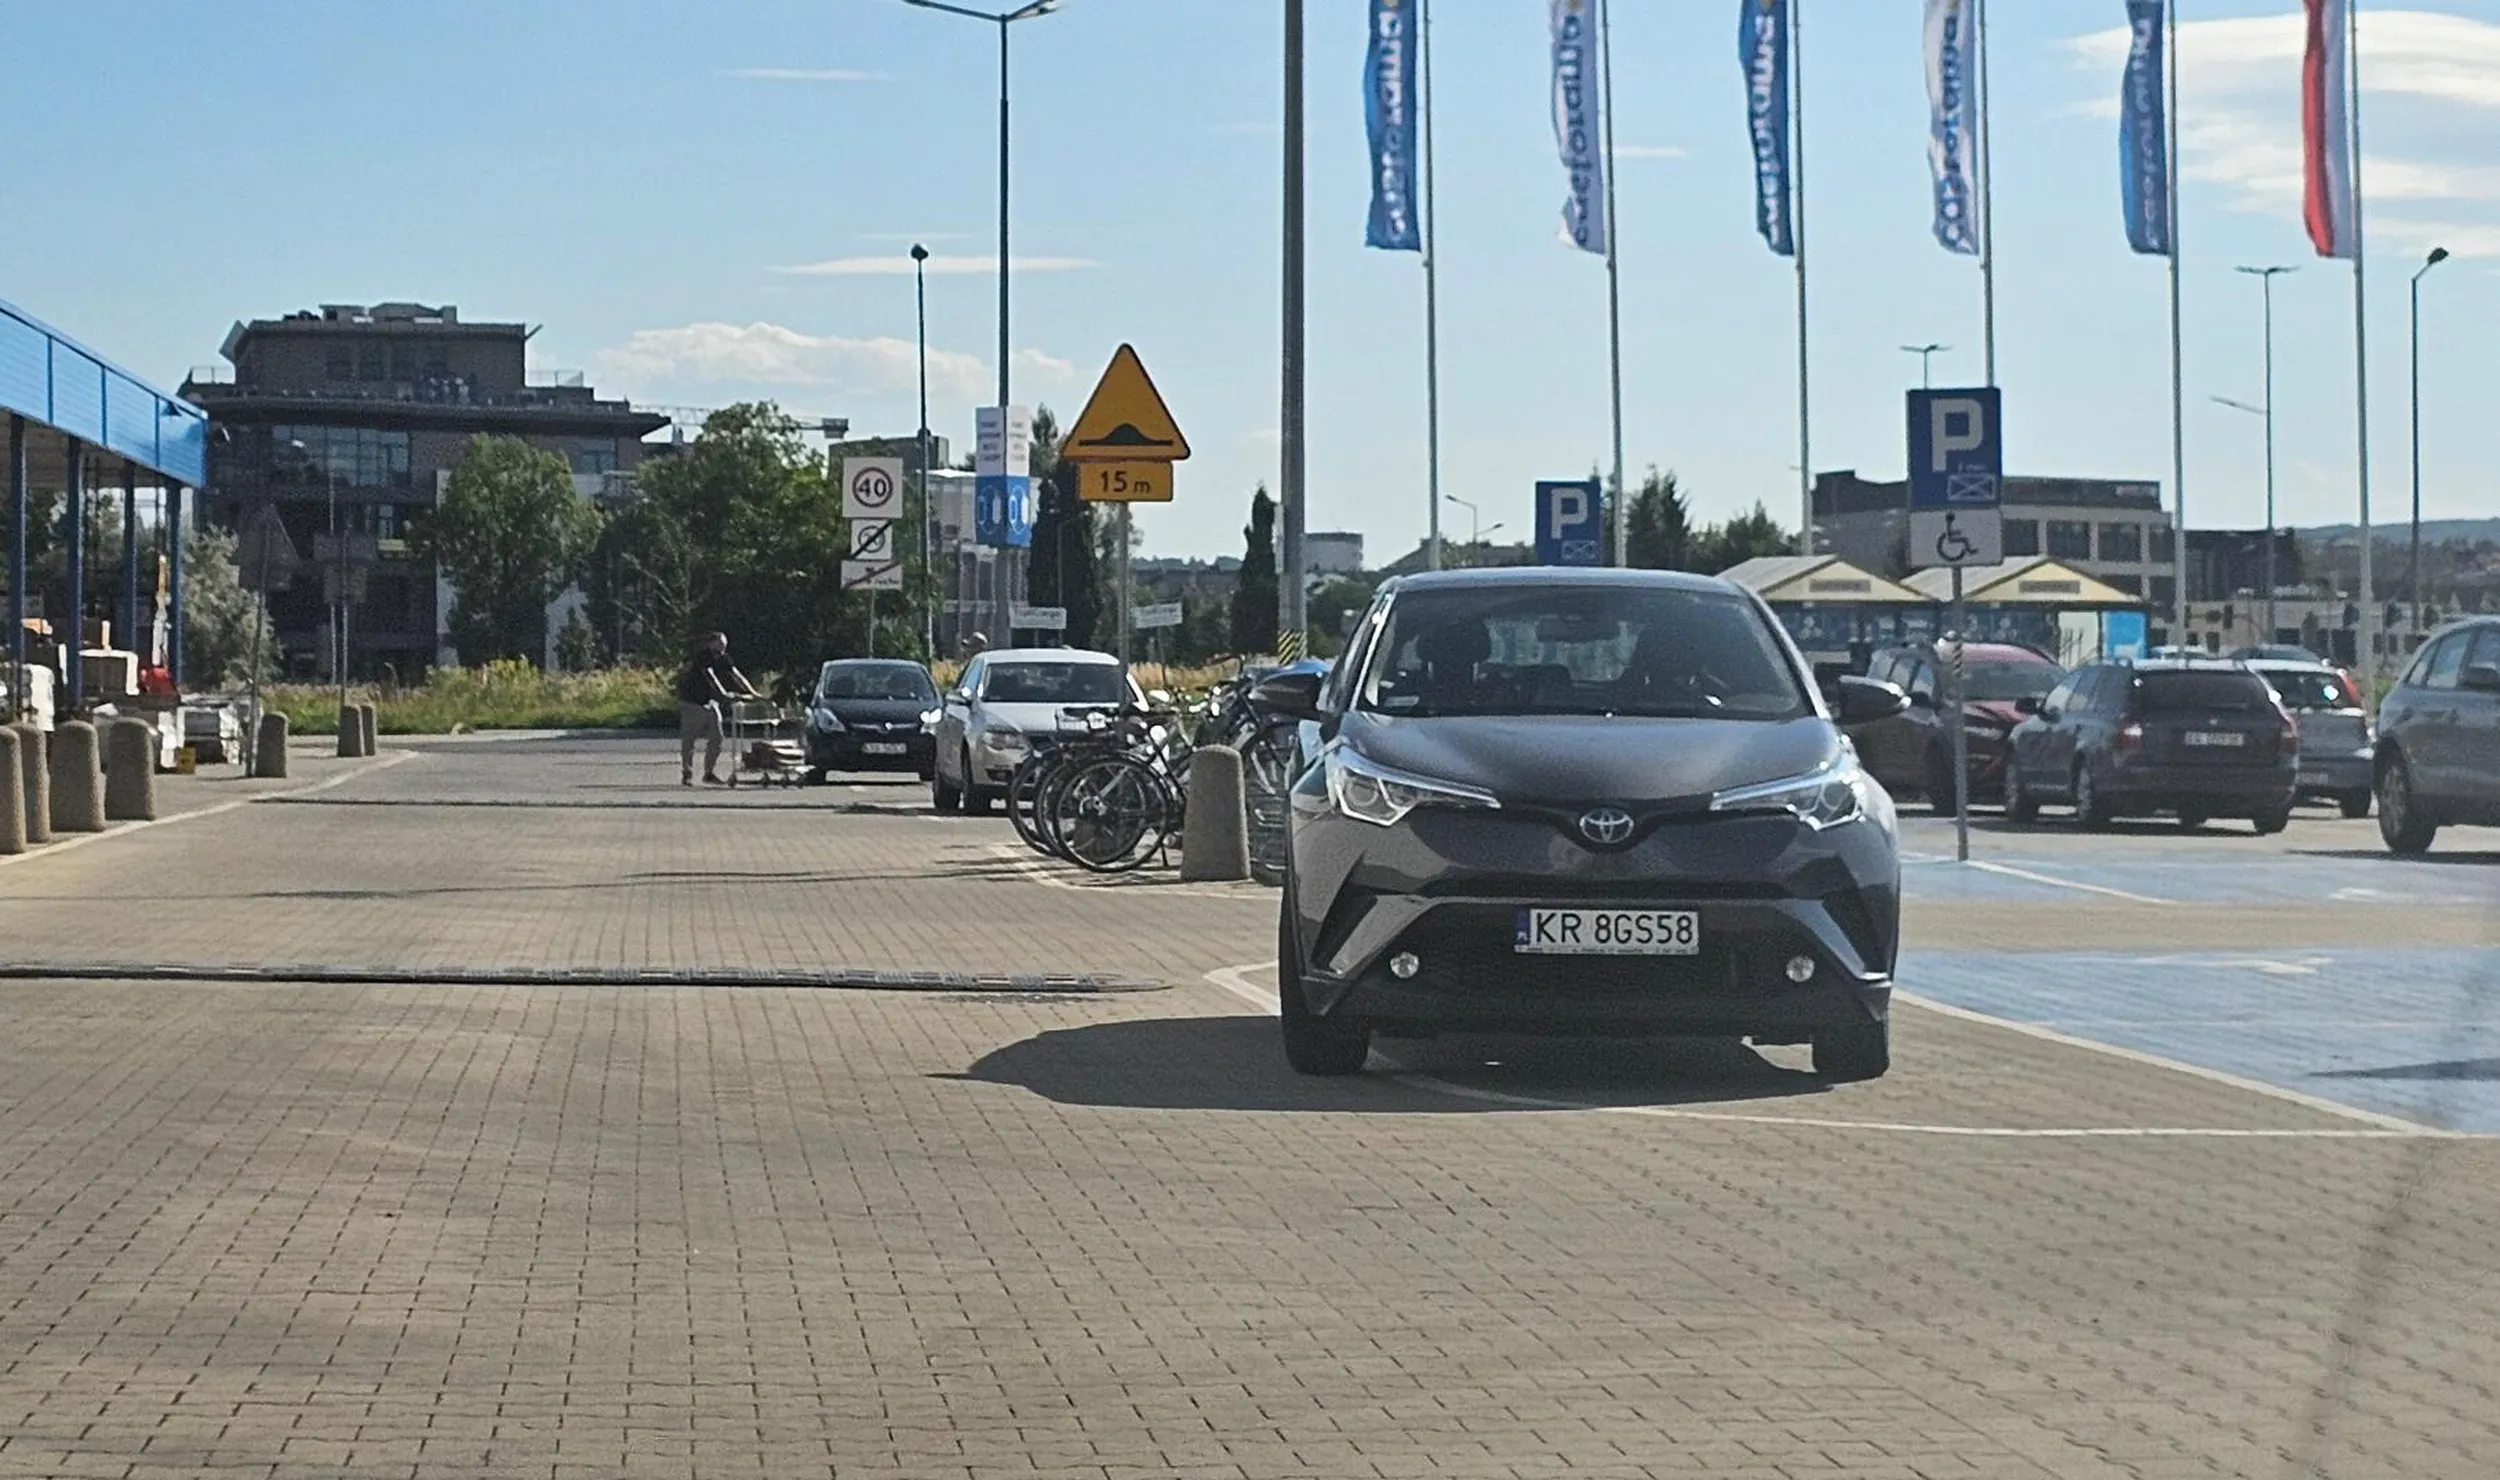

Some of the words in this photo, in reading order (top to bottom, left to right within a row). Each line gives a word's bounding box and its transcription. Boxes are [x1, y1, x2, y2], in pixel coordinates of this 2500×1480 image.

[1930, 398, 1983, 473] P
[857, 478, 888, 498] 40
[1100, 469, 1128, 493] 15
[1133, 480, 1151, 493] m
[1550, 487, 1588, 540] P
[1536, 912, 1581, 943] KR
[1594, 914, 1693, 944] 8GS58
